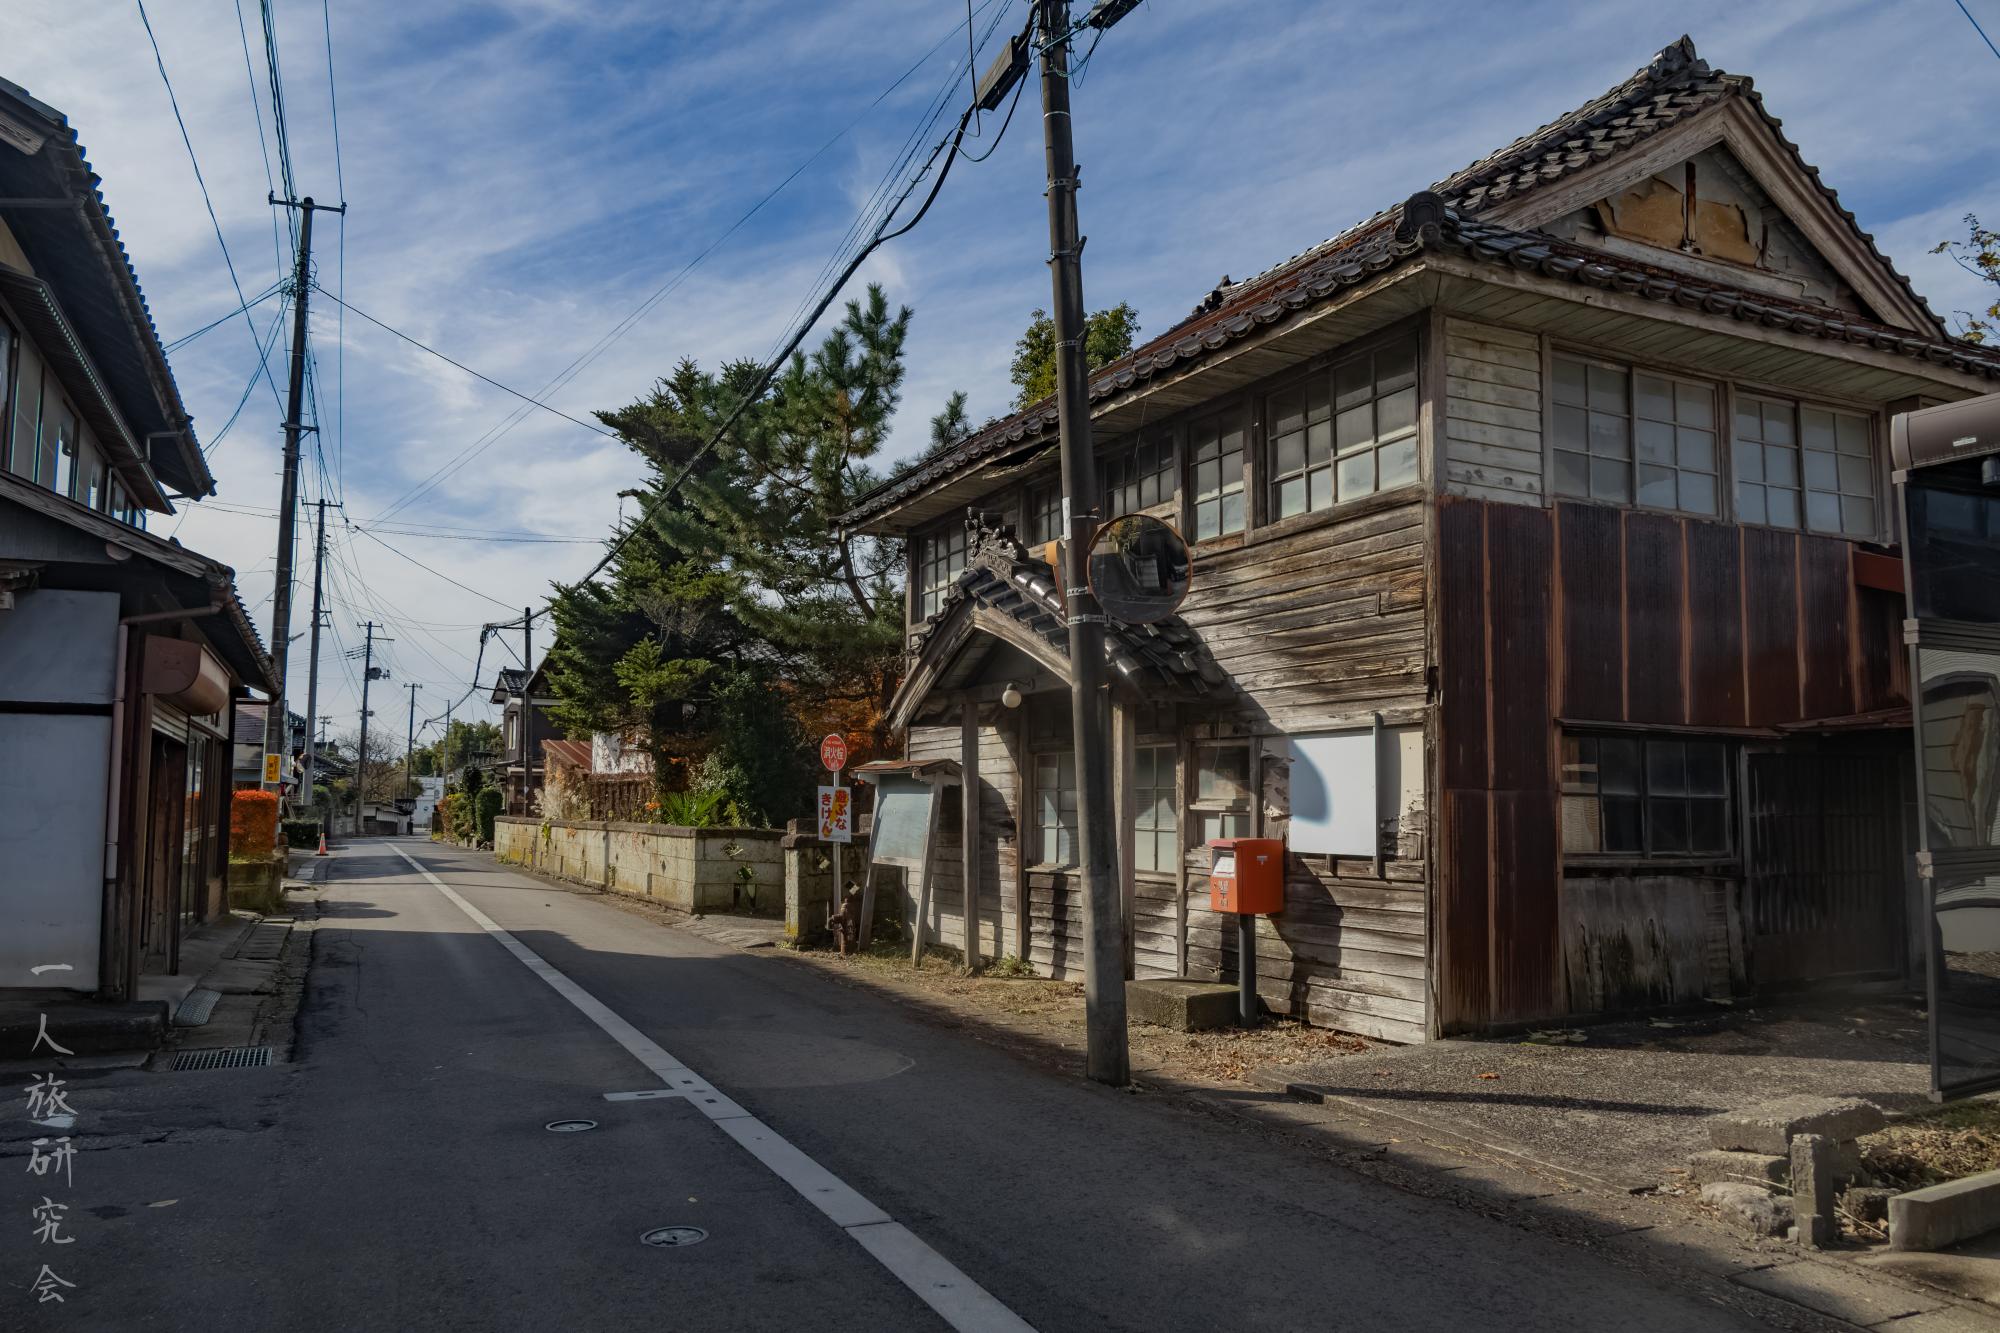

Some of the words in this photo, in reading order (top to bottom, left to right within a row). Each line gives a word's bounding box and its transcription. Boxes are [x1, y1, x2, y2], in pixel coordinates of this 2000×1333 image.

[823, 746, 844, 760] 消火栓
[821, 793, 832, 833] きけん
